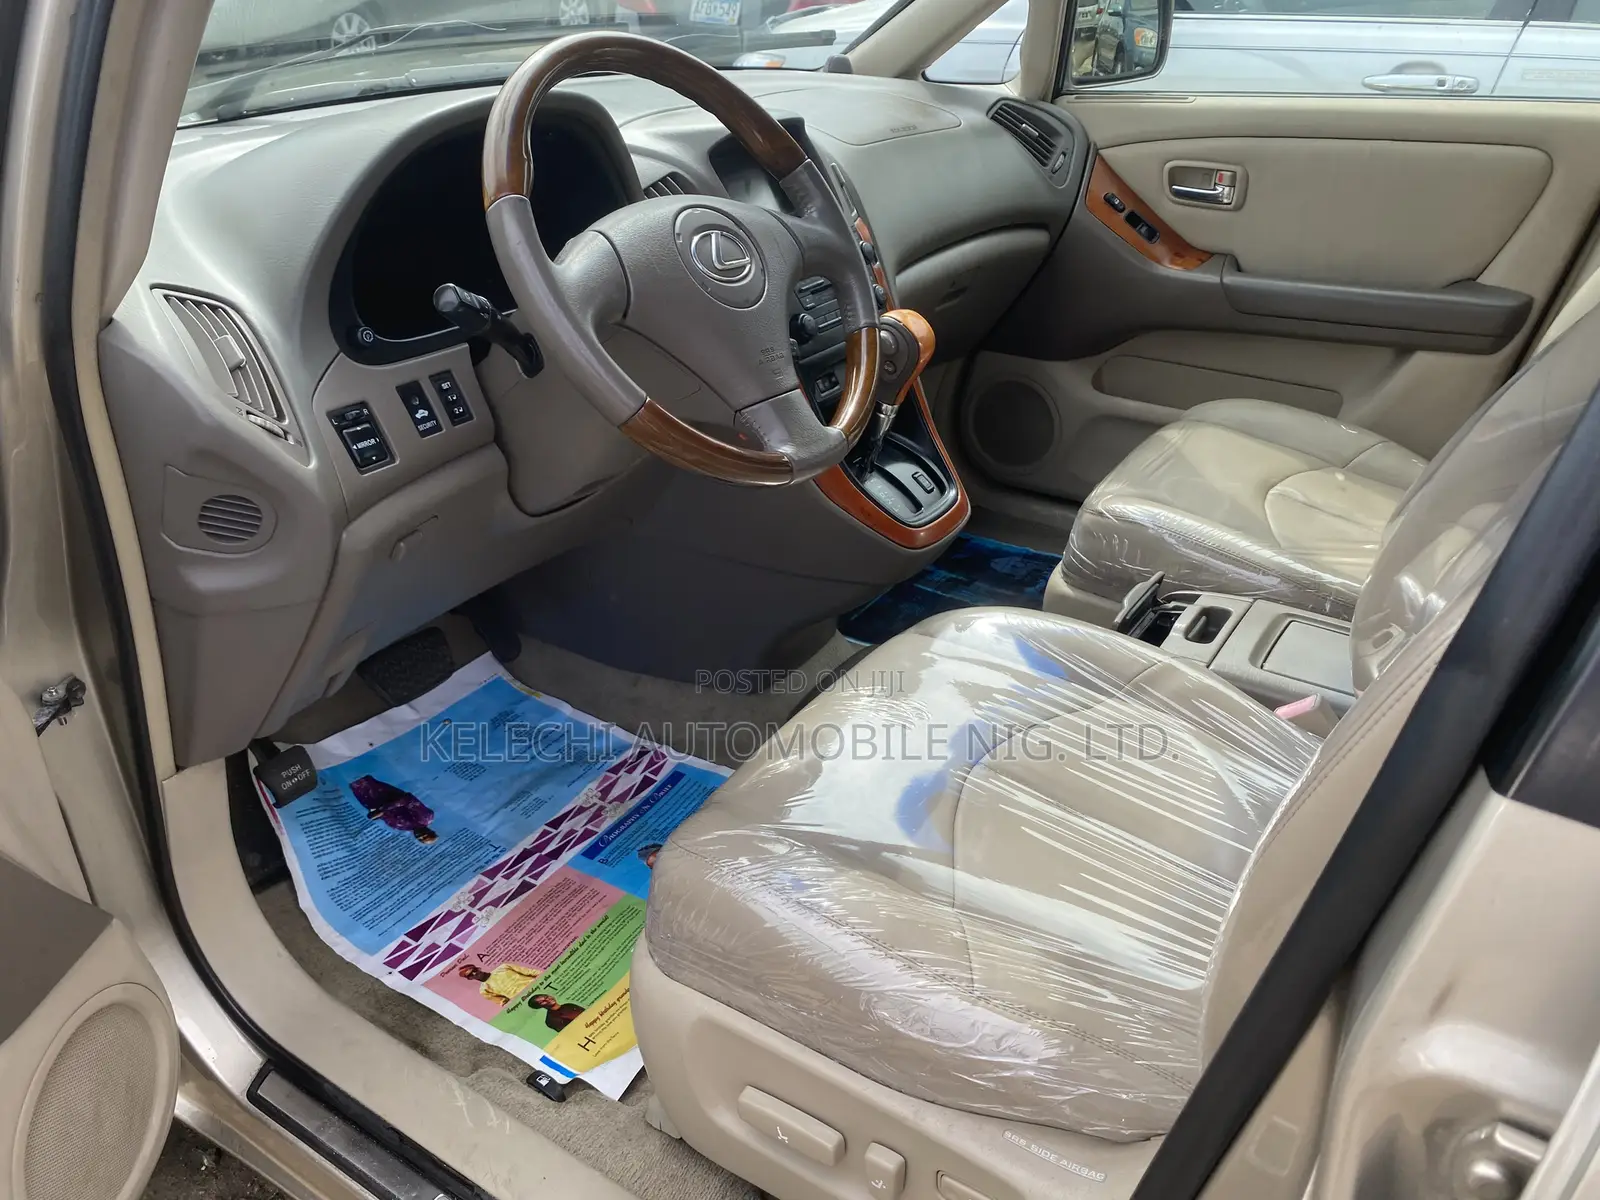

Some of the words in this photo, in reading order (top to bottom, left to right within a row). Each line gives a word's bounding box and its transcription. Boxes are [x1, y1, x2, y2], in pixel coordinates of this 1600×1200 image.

[362, 408, 370, 416] R
[331, 418, 339, 426] L
[417, 419, 438, 431] SECURITY
[356, 437, 377, 449] MIRROR
[281, 764, 302, 778] PUSH
[281, 780, 293, 790] ON
[297, 768, 311, 781] OFF
[506, 1001, 523, 1014] Happy
[584, 1015, 601, 1028] Happy
[1003, 1130, 1027, 1147] SRS
[1030, 1144, 1059, 1162] SIDE
[1059, 1159, 1106, 1181] AIRBAG
